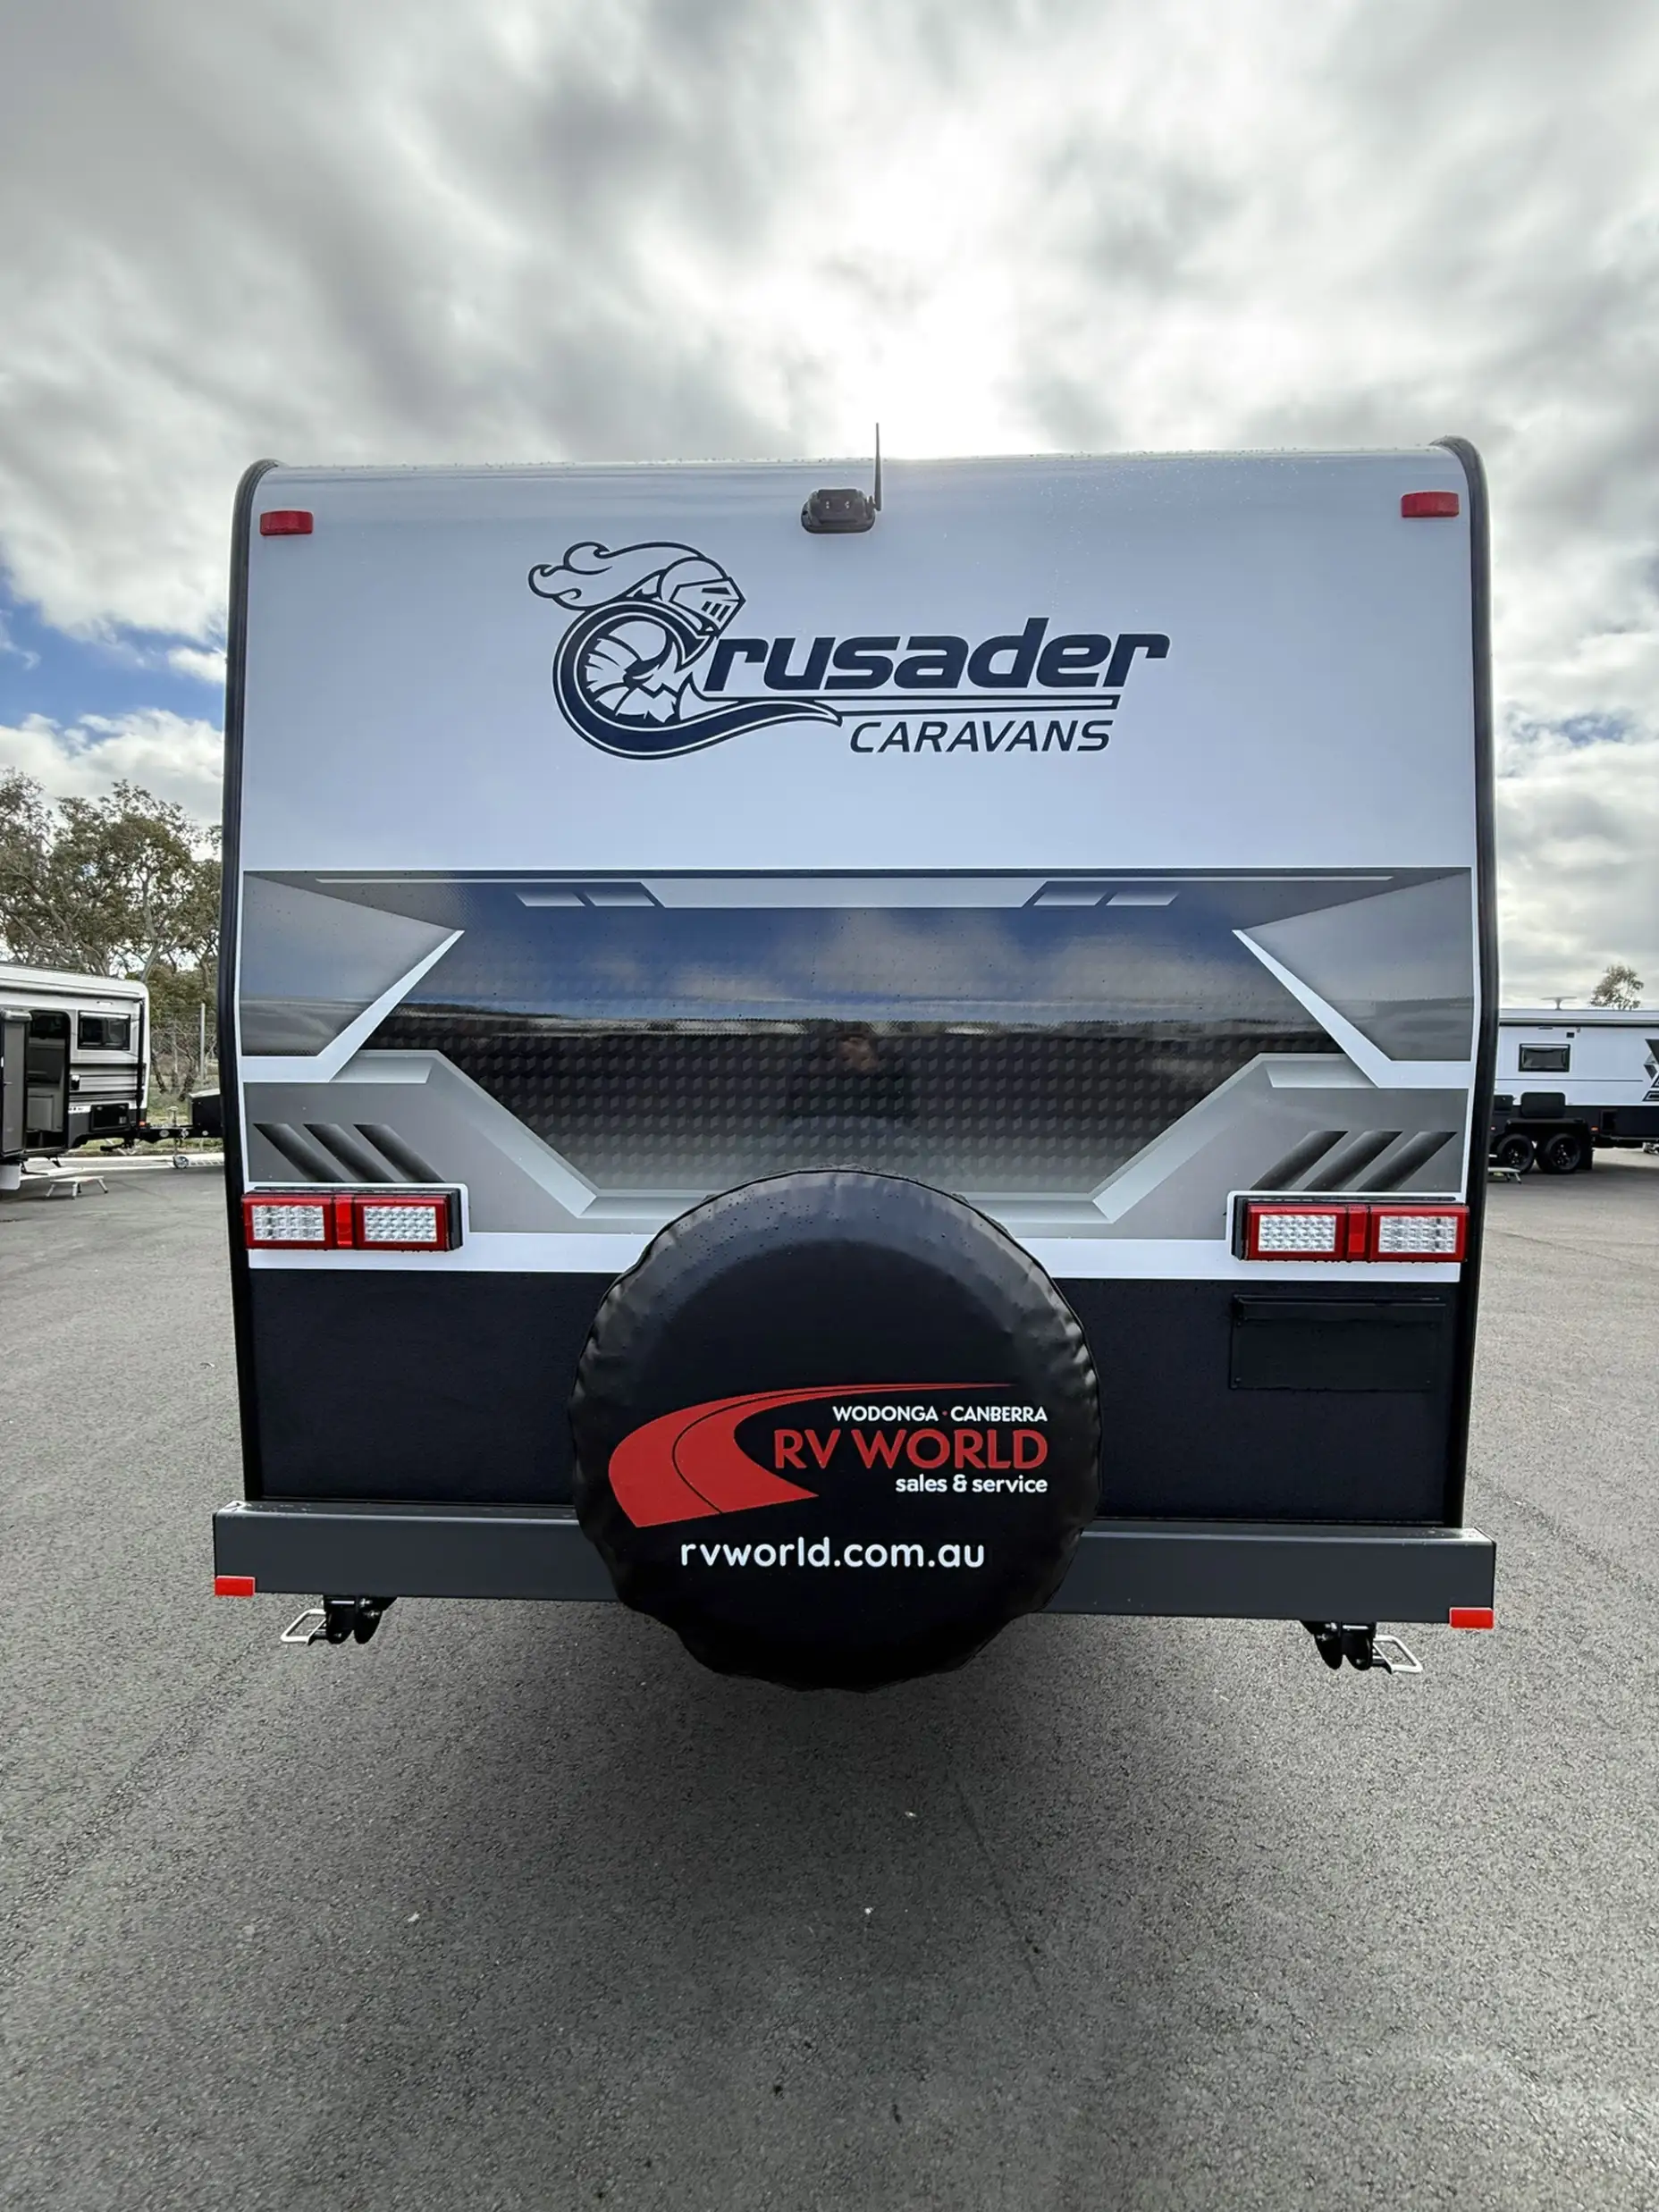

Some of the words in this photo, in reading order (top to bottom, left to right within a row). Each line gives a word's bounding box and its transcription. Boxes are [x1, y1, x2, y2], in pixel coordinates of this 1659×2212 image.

[849, 719, 1115, 753] CARAVANS
[832, 1405, 939, 1422] WODONGA
[950, 1405, 1048, 1423] CANBERRA
[774, 1428, 841, 1469] RV
[850, 1428, 1048, 1469] WORLD
[895, 1474, 947, 1493] sales
[952, 1473, 968, 1493] &
[972, 1474, 1048, 1493] service
[680, 1536, 984, 1569] rvworld.com.au
